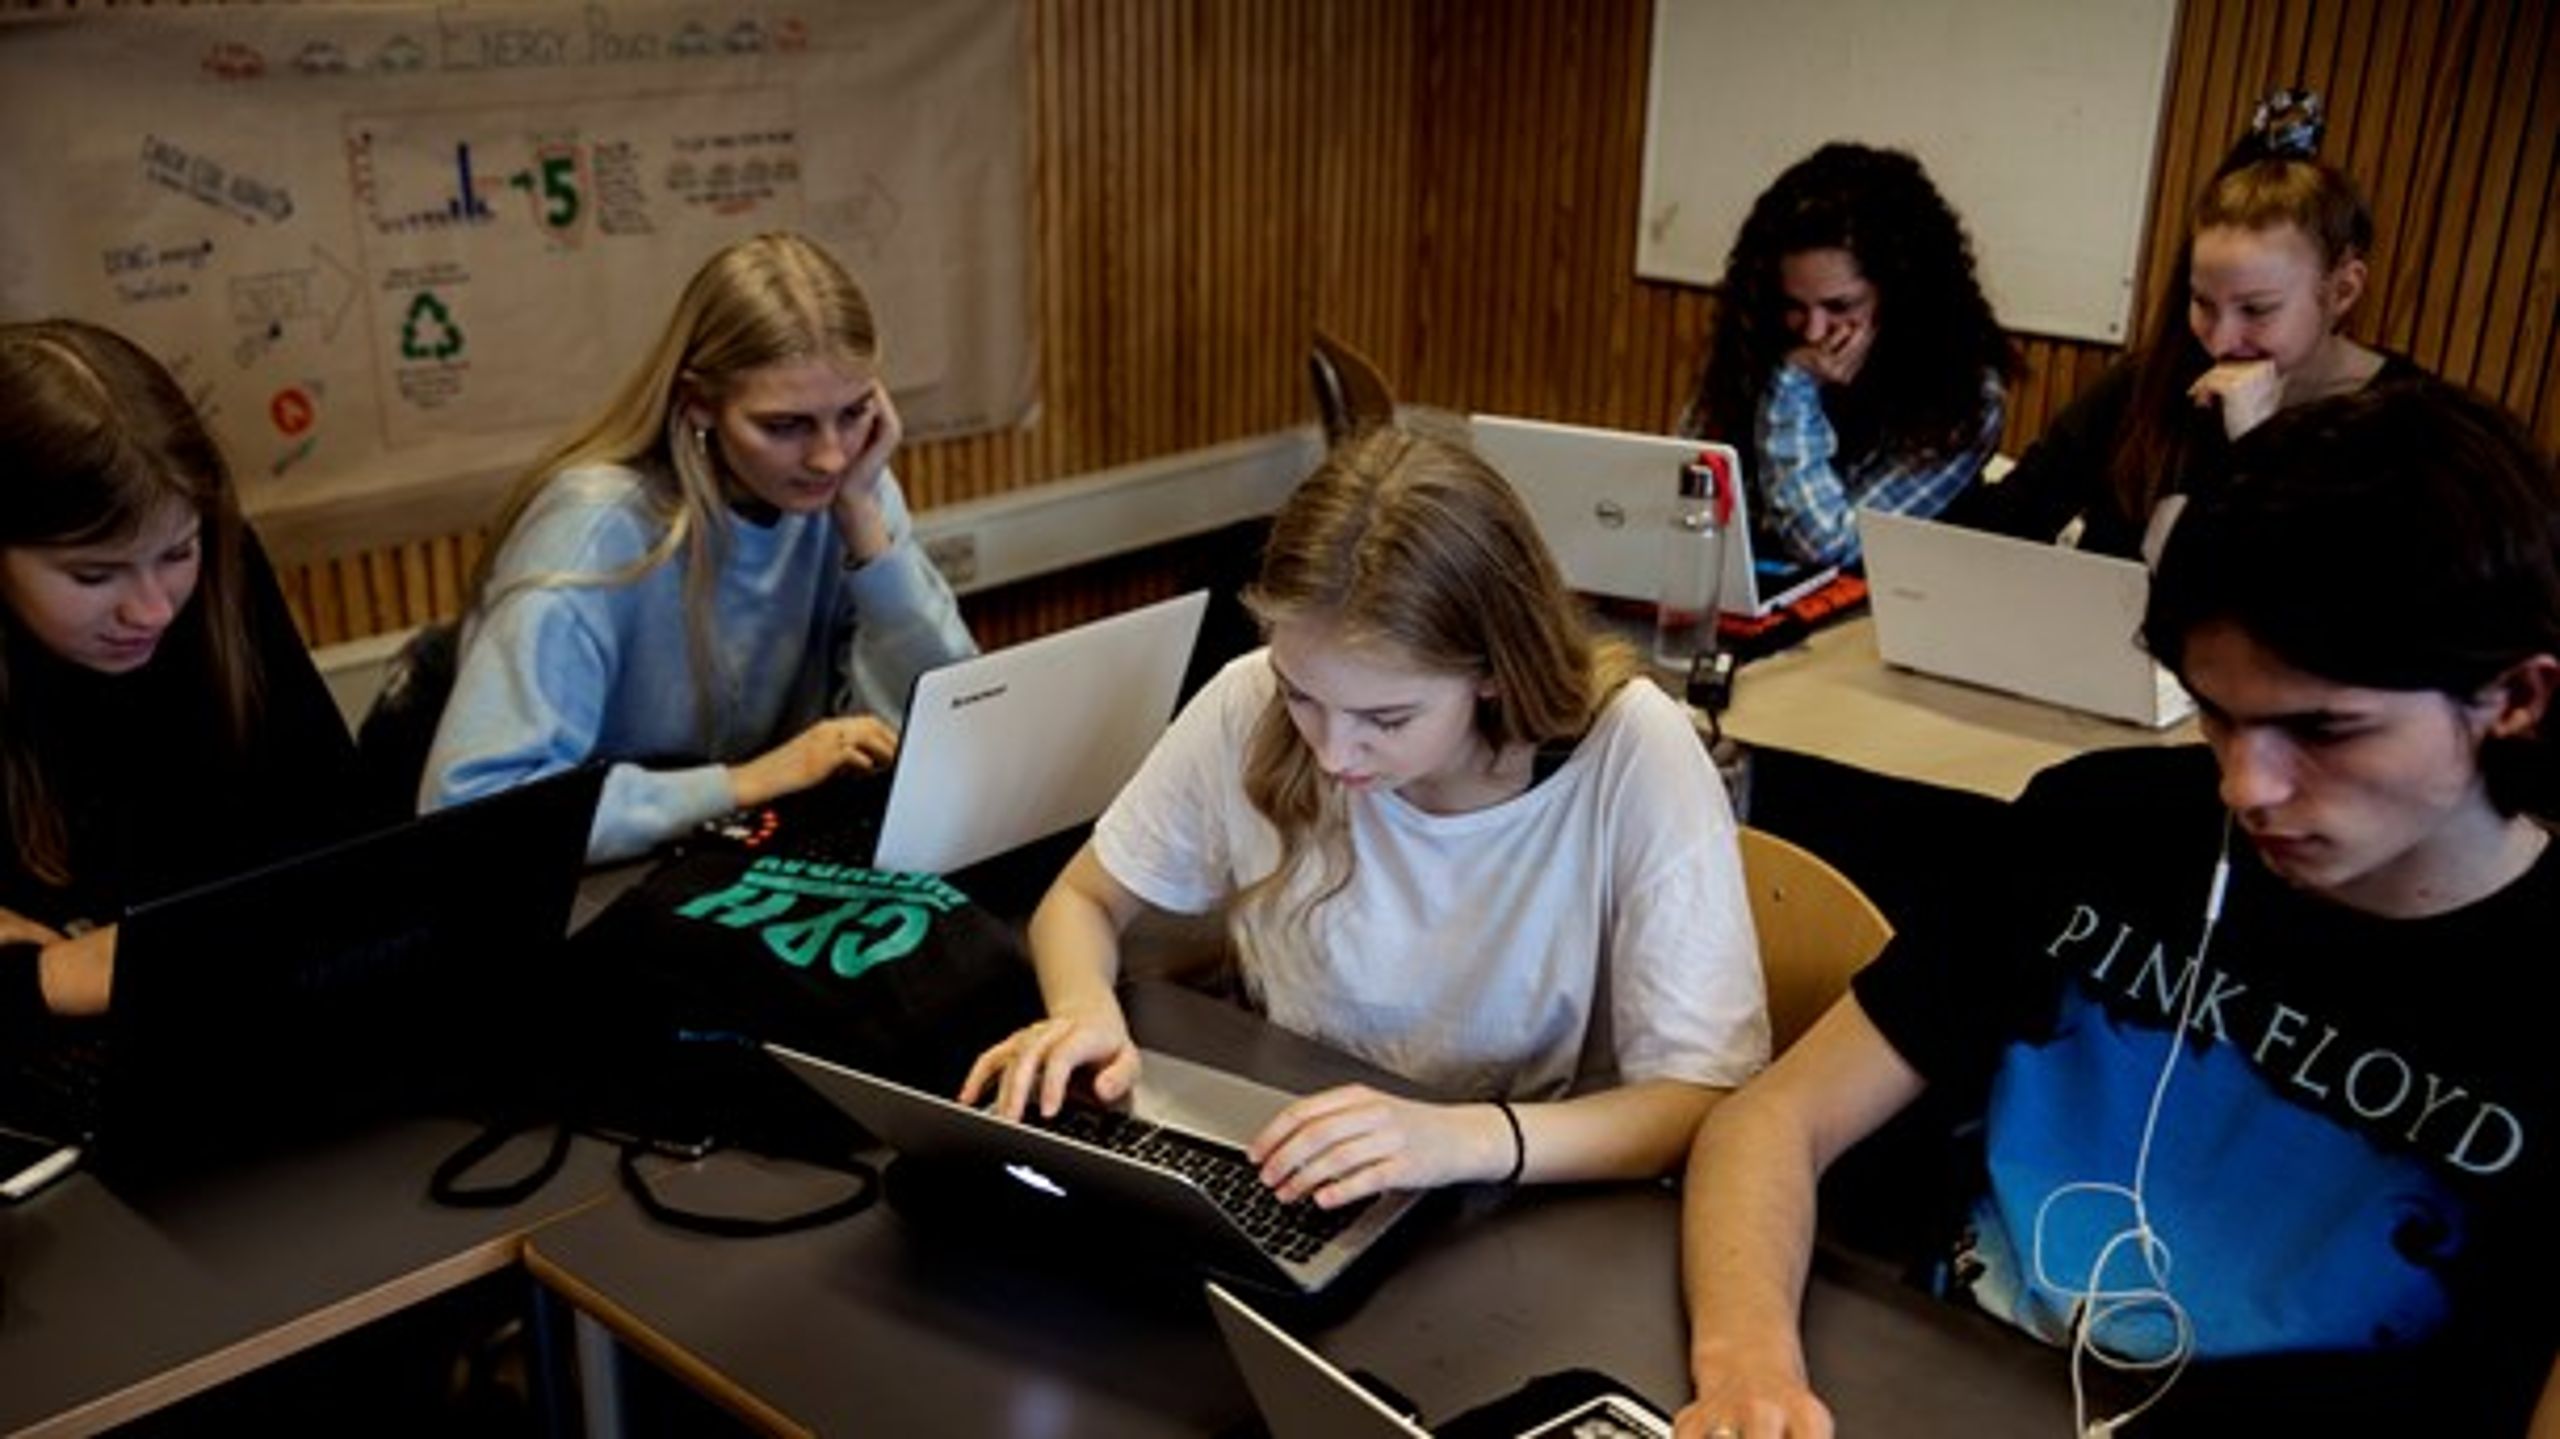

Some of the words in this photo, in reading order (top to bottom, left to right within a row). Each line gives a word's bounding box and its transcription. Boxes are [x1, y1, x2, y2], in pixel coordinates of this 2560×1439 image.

[541, 157, 579, 229] 5
[671, 883, 932, 980] CPH
[2046, 904, 2247, 1043] PINK
[2252, 1005, 2524, 1175] FLOYD
